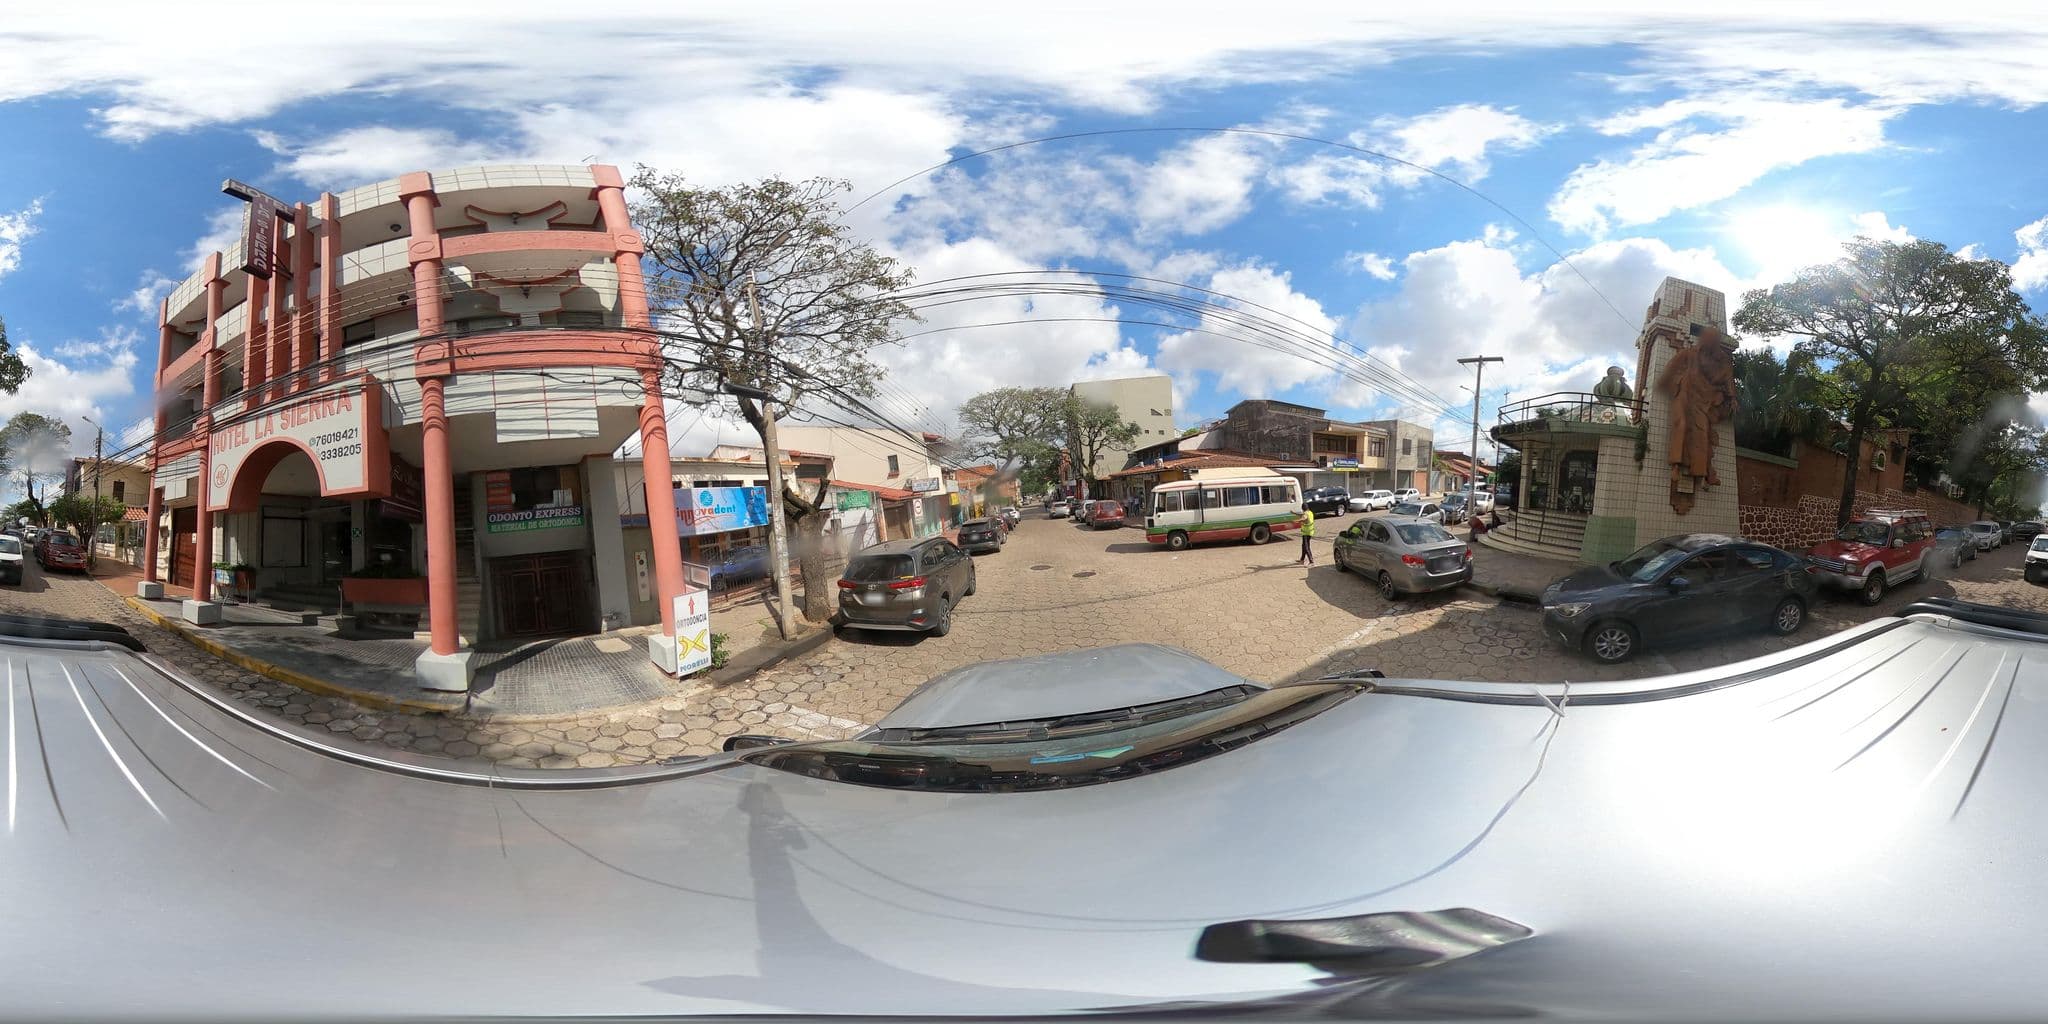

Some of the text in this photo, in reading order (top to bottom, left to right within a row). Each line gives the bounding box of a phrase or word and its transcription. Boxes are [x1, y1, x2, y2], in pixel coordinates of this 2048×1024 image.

[213, 386, 353, 456] HOTEL LA SIERRA
[315, 427, 359, 447] 76018421
[320, 443, 362, 461] 3338205
[488, 506, 581, 523] ODONTO EXPRESS
[676, 613, 707, 629] ORTODONCIA
